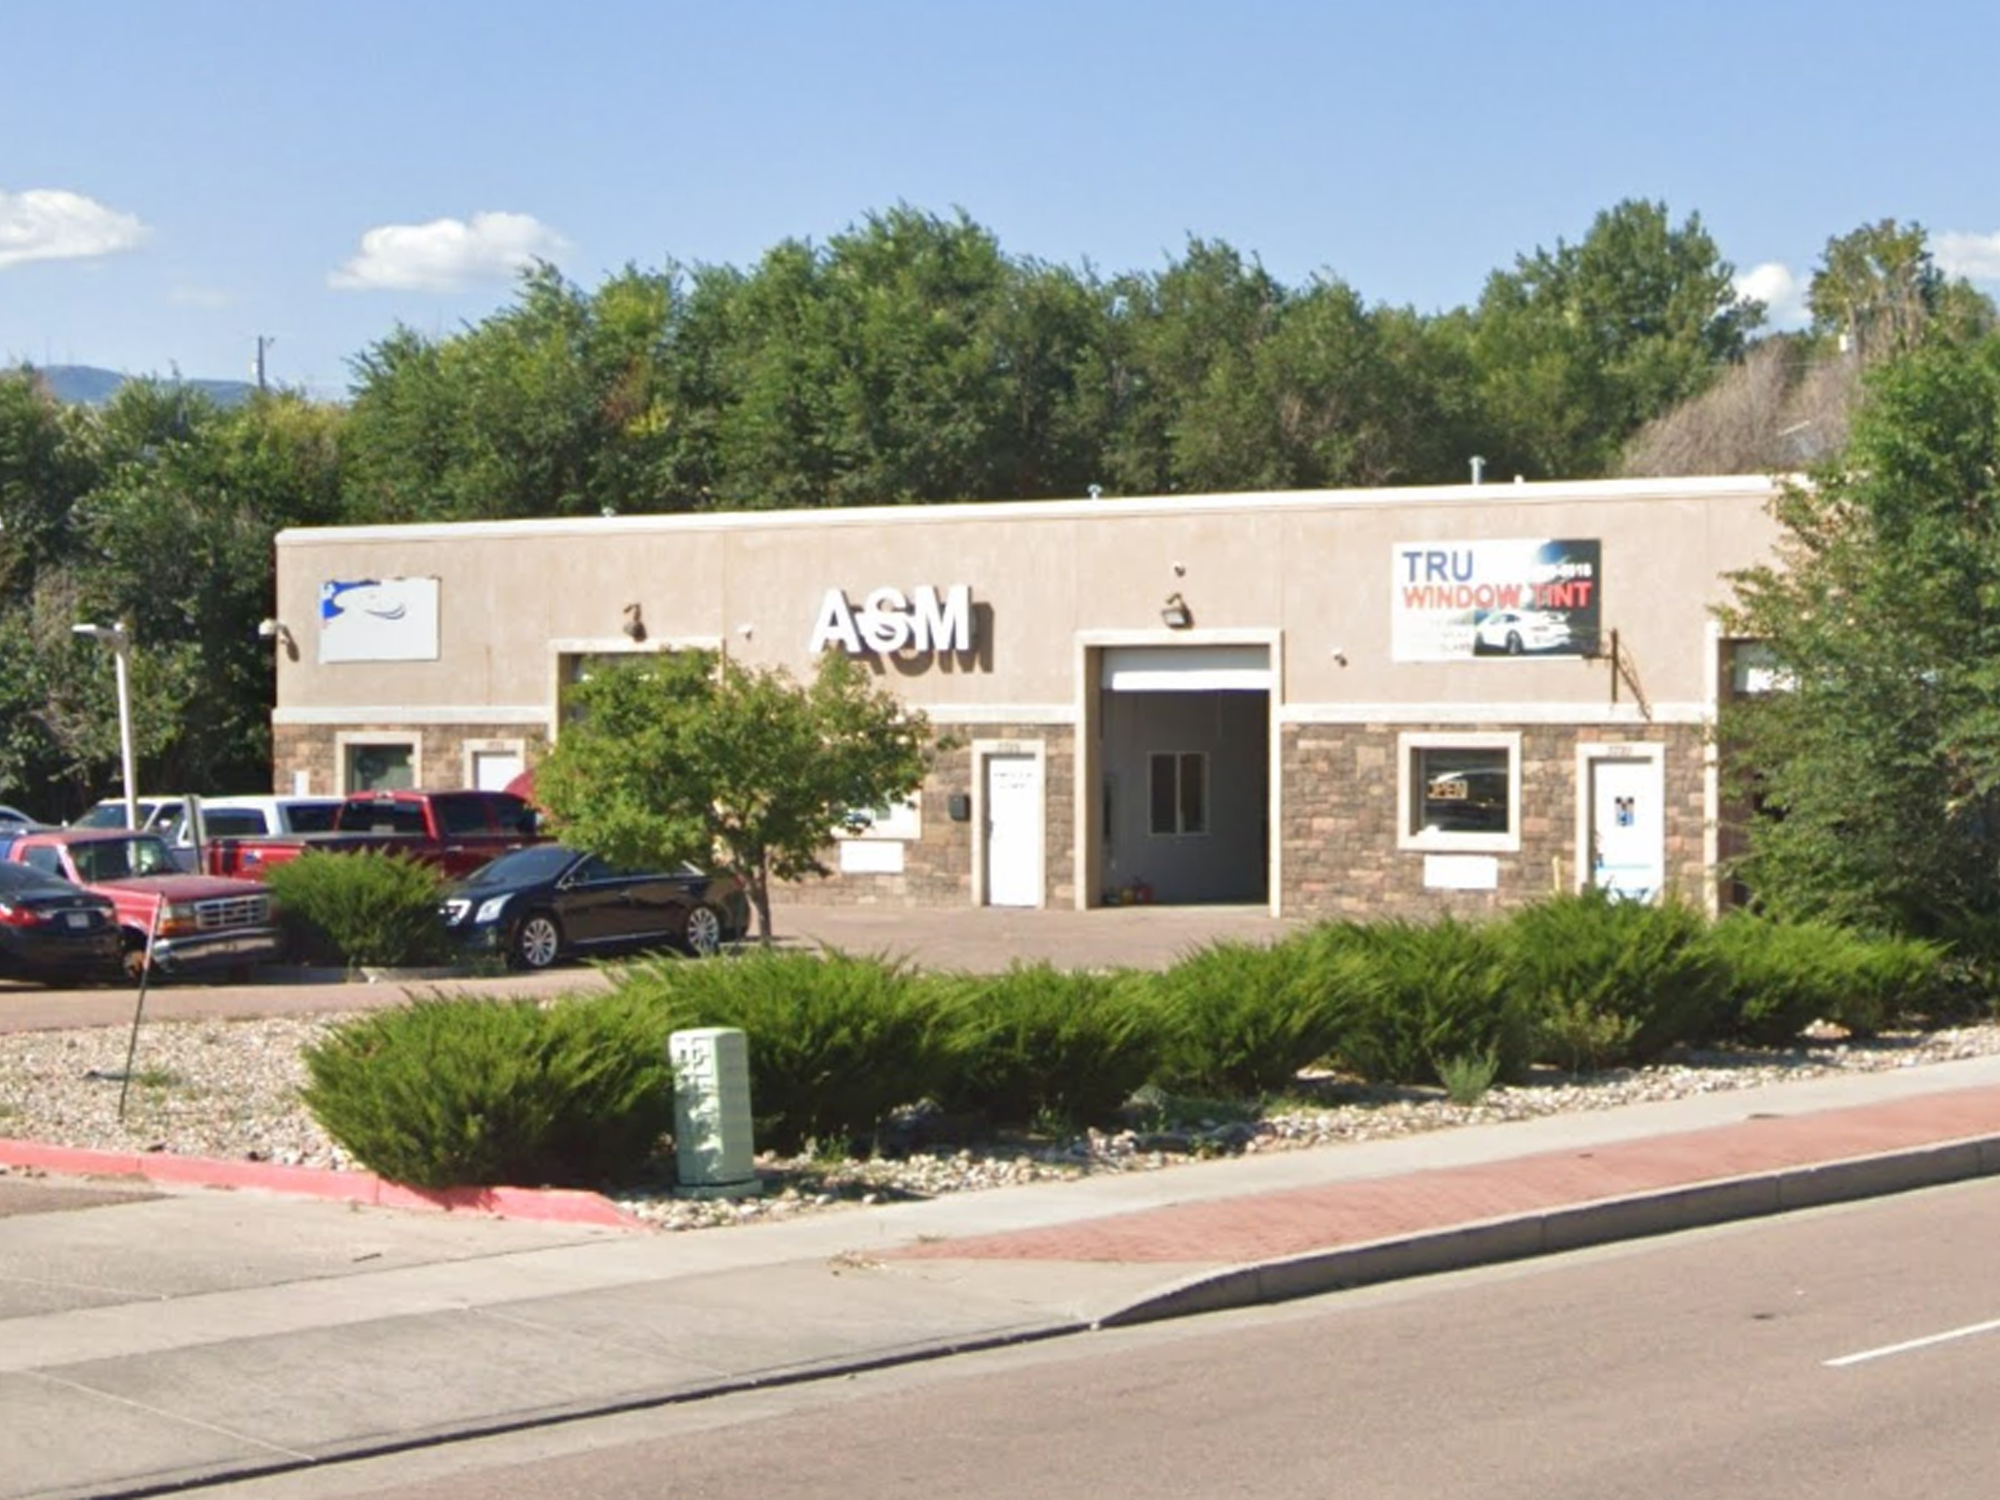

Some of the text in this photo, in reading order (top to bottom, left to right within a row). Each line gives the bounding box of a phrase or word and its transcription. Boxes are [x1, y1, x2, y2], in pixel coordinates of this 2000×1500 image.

[1402, 551, 1473, 582] TRU
[1403, 582, 1593, 609] WINDOW TINT
[809, 584, 970, 653] ASM
